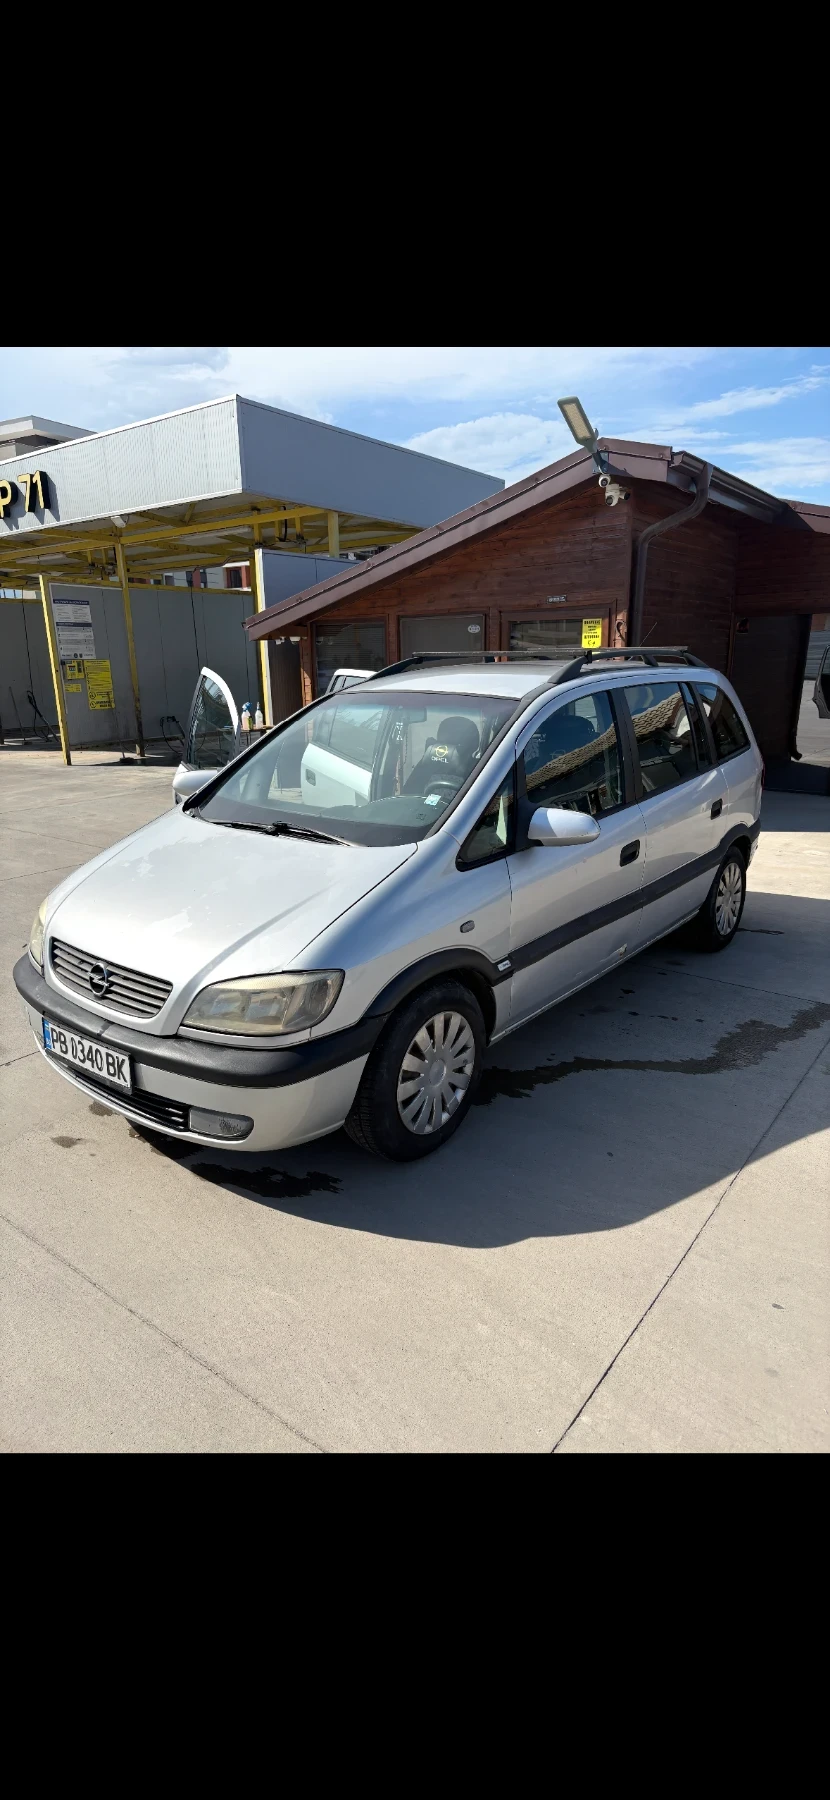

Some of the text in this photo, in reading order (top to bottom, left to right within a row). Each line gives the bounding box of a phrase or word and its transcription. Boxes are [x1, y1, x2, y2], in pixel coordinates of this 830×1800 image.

[17, 469, 48, 513] 71
[50, 1027, 128, 1083] PB 0340 BK
